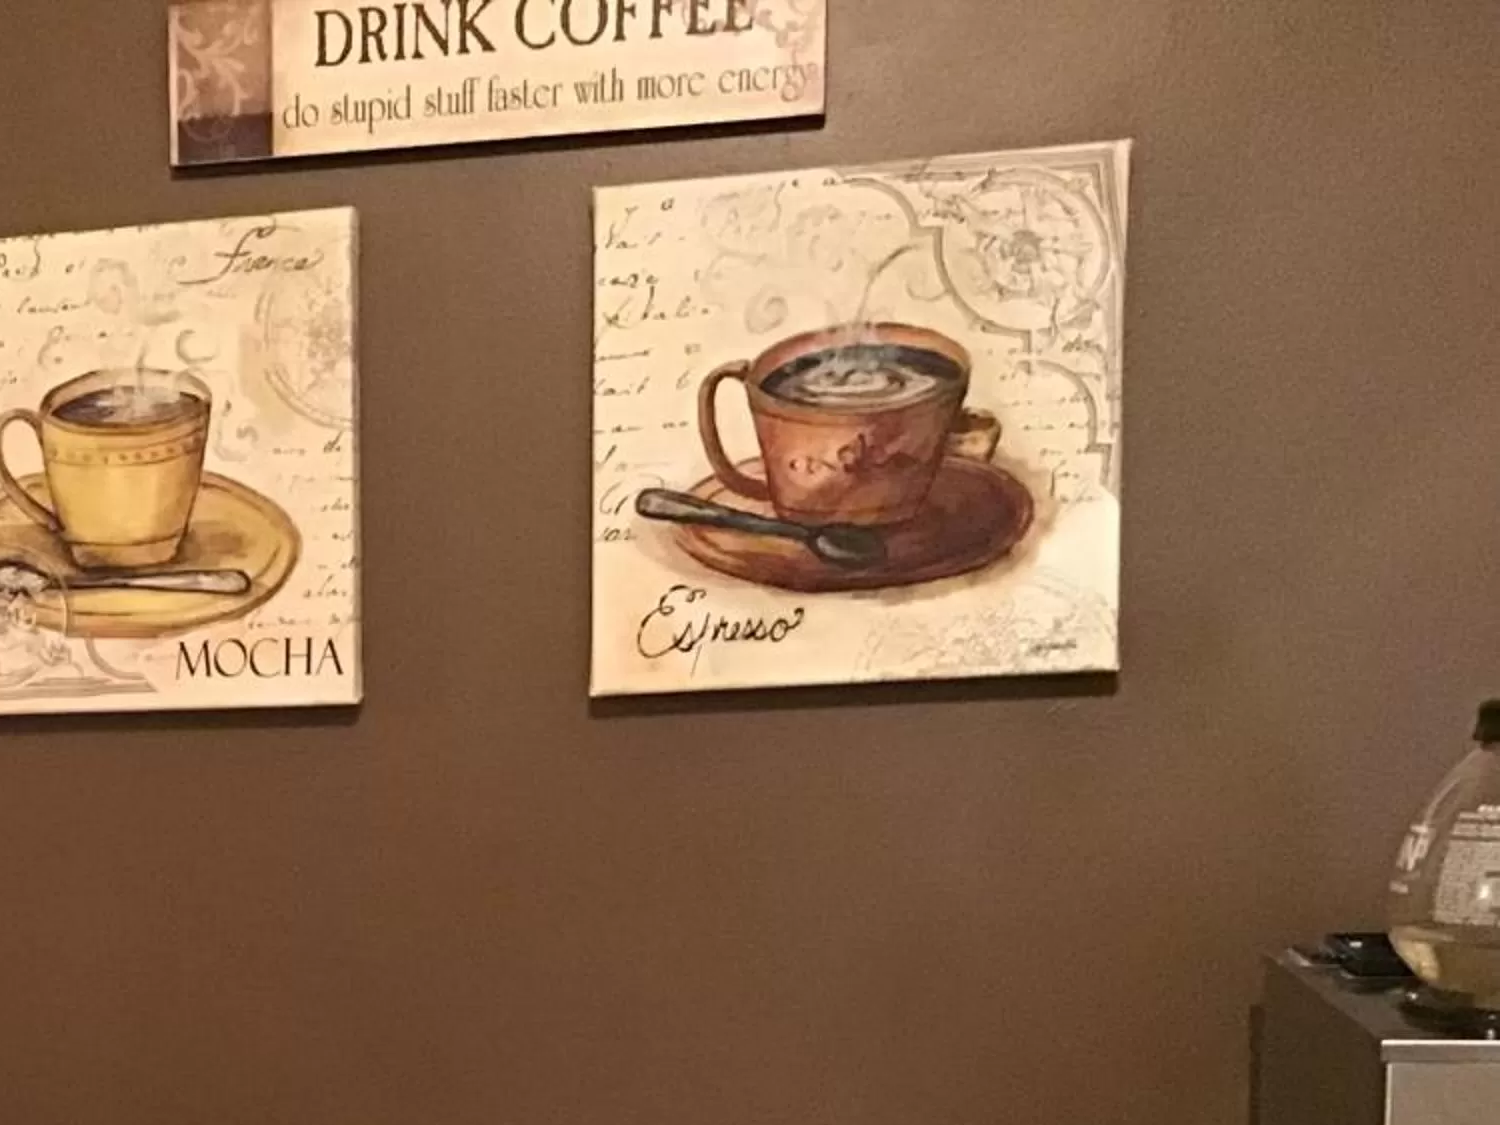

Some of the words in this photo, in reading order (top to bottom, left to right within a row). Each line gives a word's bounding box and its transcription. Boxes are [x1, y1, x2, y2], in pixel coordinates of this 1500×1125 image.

[314, 0, 497, 67] DRINK
[282, 93, 319, 129] do
[329, 84, 411, 135] stupid
[422, 76, 481, 118] stuff
[487, 74, 563, 113] faster
[573, 65, 625, 105] with
[637, 71, 706, 101] more
[175, 636, 345, 681] MOCHA
